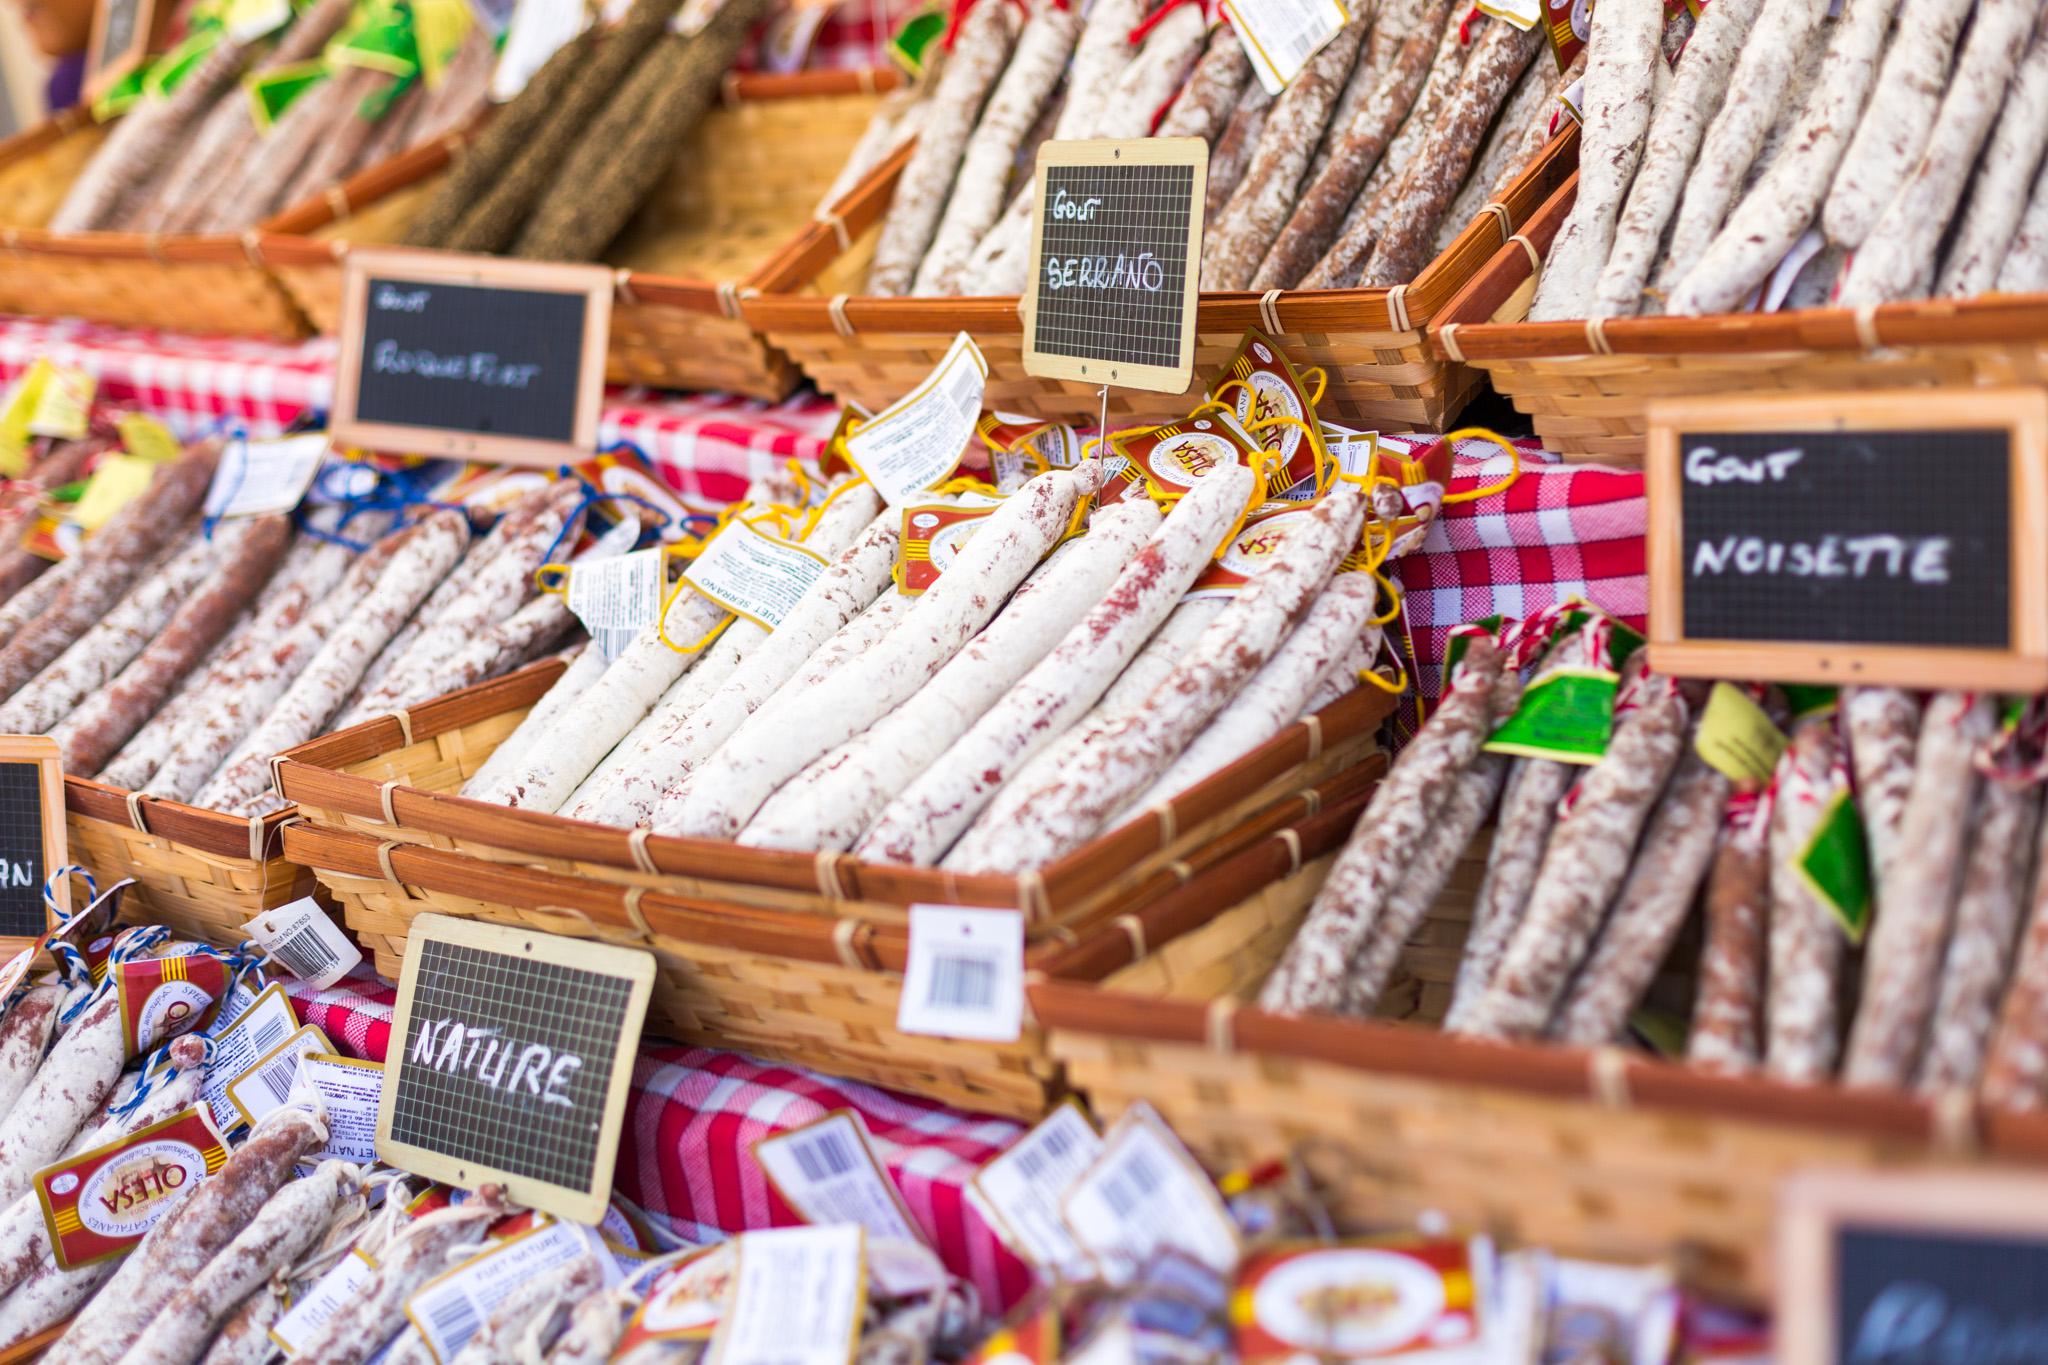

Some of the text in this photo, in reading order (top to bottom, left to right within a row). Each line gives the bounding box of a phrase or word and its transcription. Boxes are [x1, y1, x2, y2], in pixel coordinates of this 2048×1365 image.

[701, 577, 782, 626] FUET SERRANO
[412, 1017, 582, 1108] NATURE
[322, 1141, 355, 1157] NATU
[98, 1164, 188, 1215] OLESA
[87, 1215, 149, 1233] CATALANES
